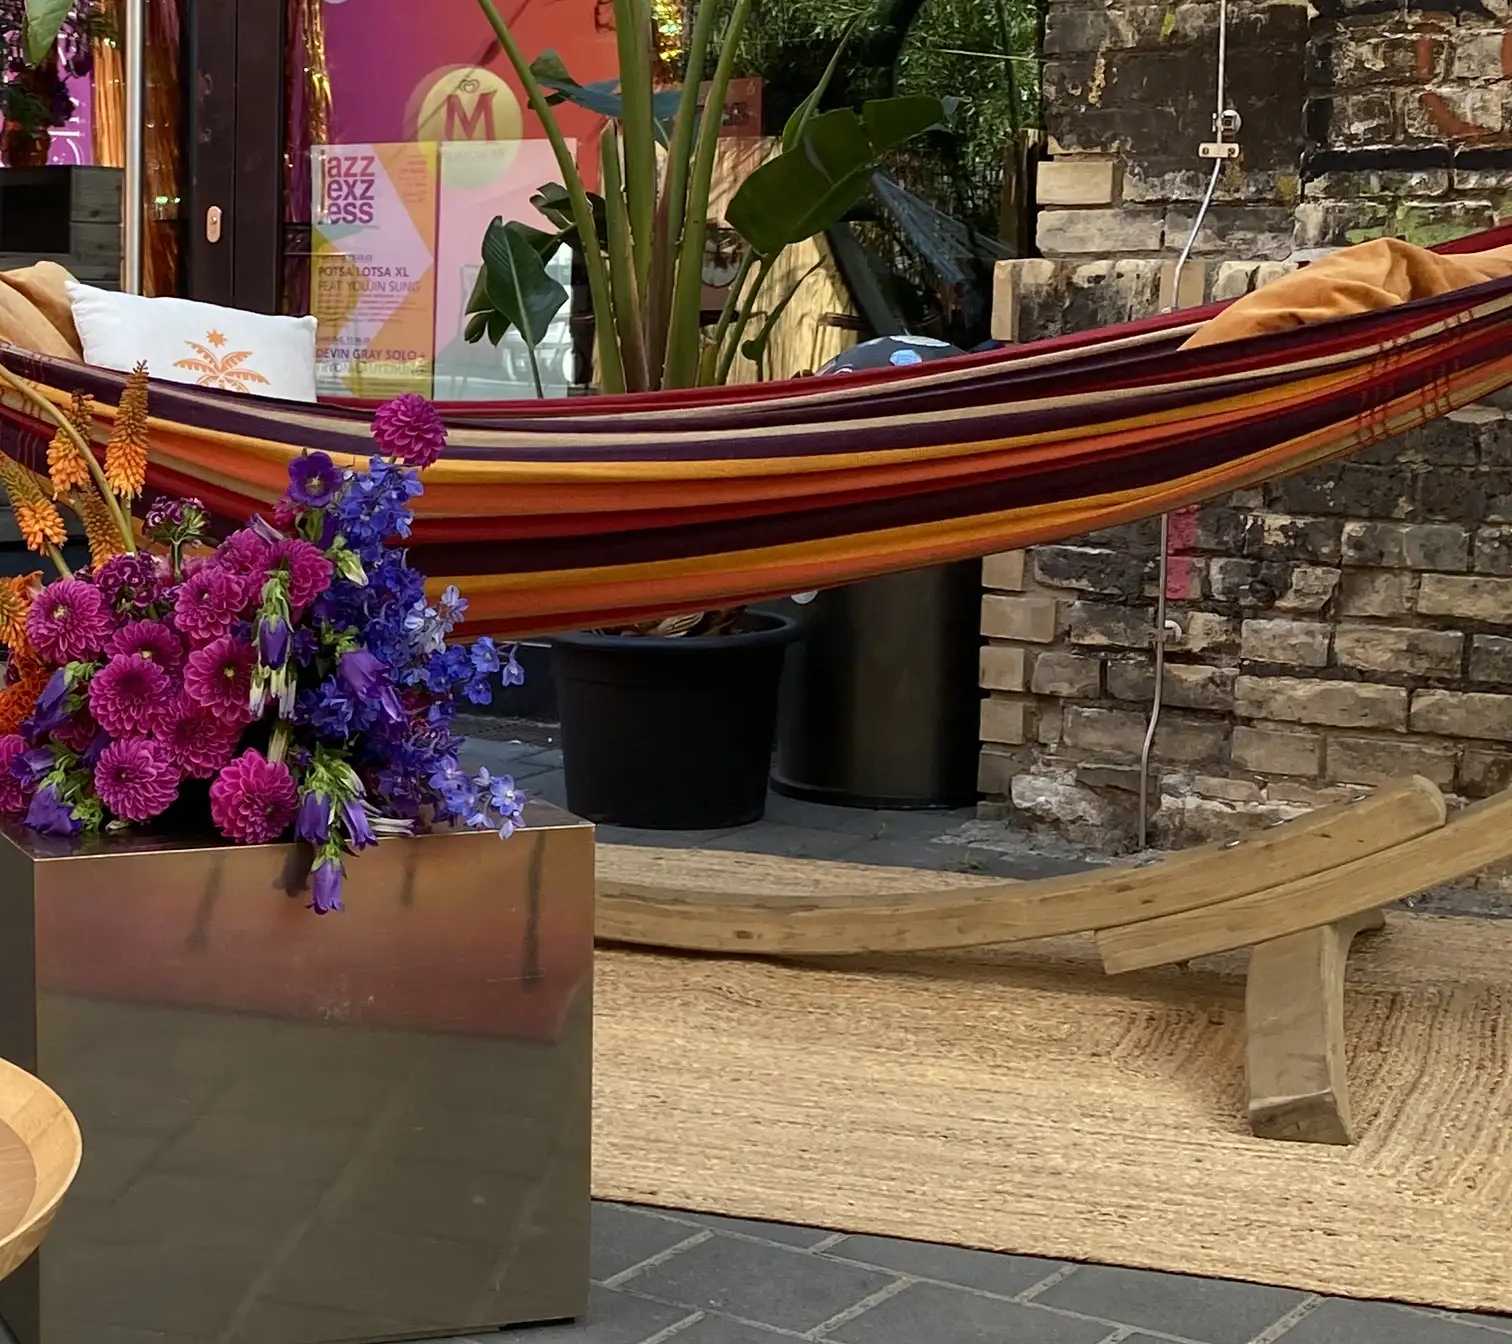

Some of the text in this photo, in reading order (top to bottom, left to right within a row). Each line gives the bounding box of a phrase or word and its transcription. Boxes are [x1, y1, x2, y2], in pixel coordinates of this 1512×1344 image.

[445, 89, 498, 143] M
[316, 149, 375, 178] jazz
[318, 267, 410, 277] POTSA LOTSA XL
[316, 348, 349, 358] DEVIN
[353, 348, 383, 360] GRAY
[386, 349, 417, 360] SOLO
